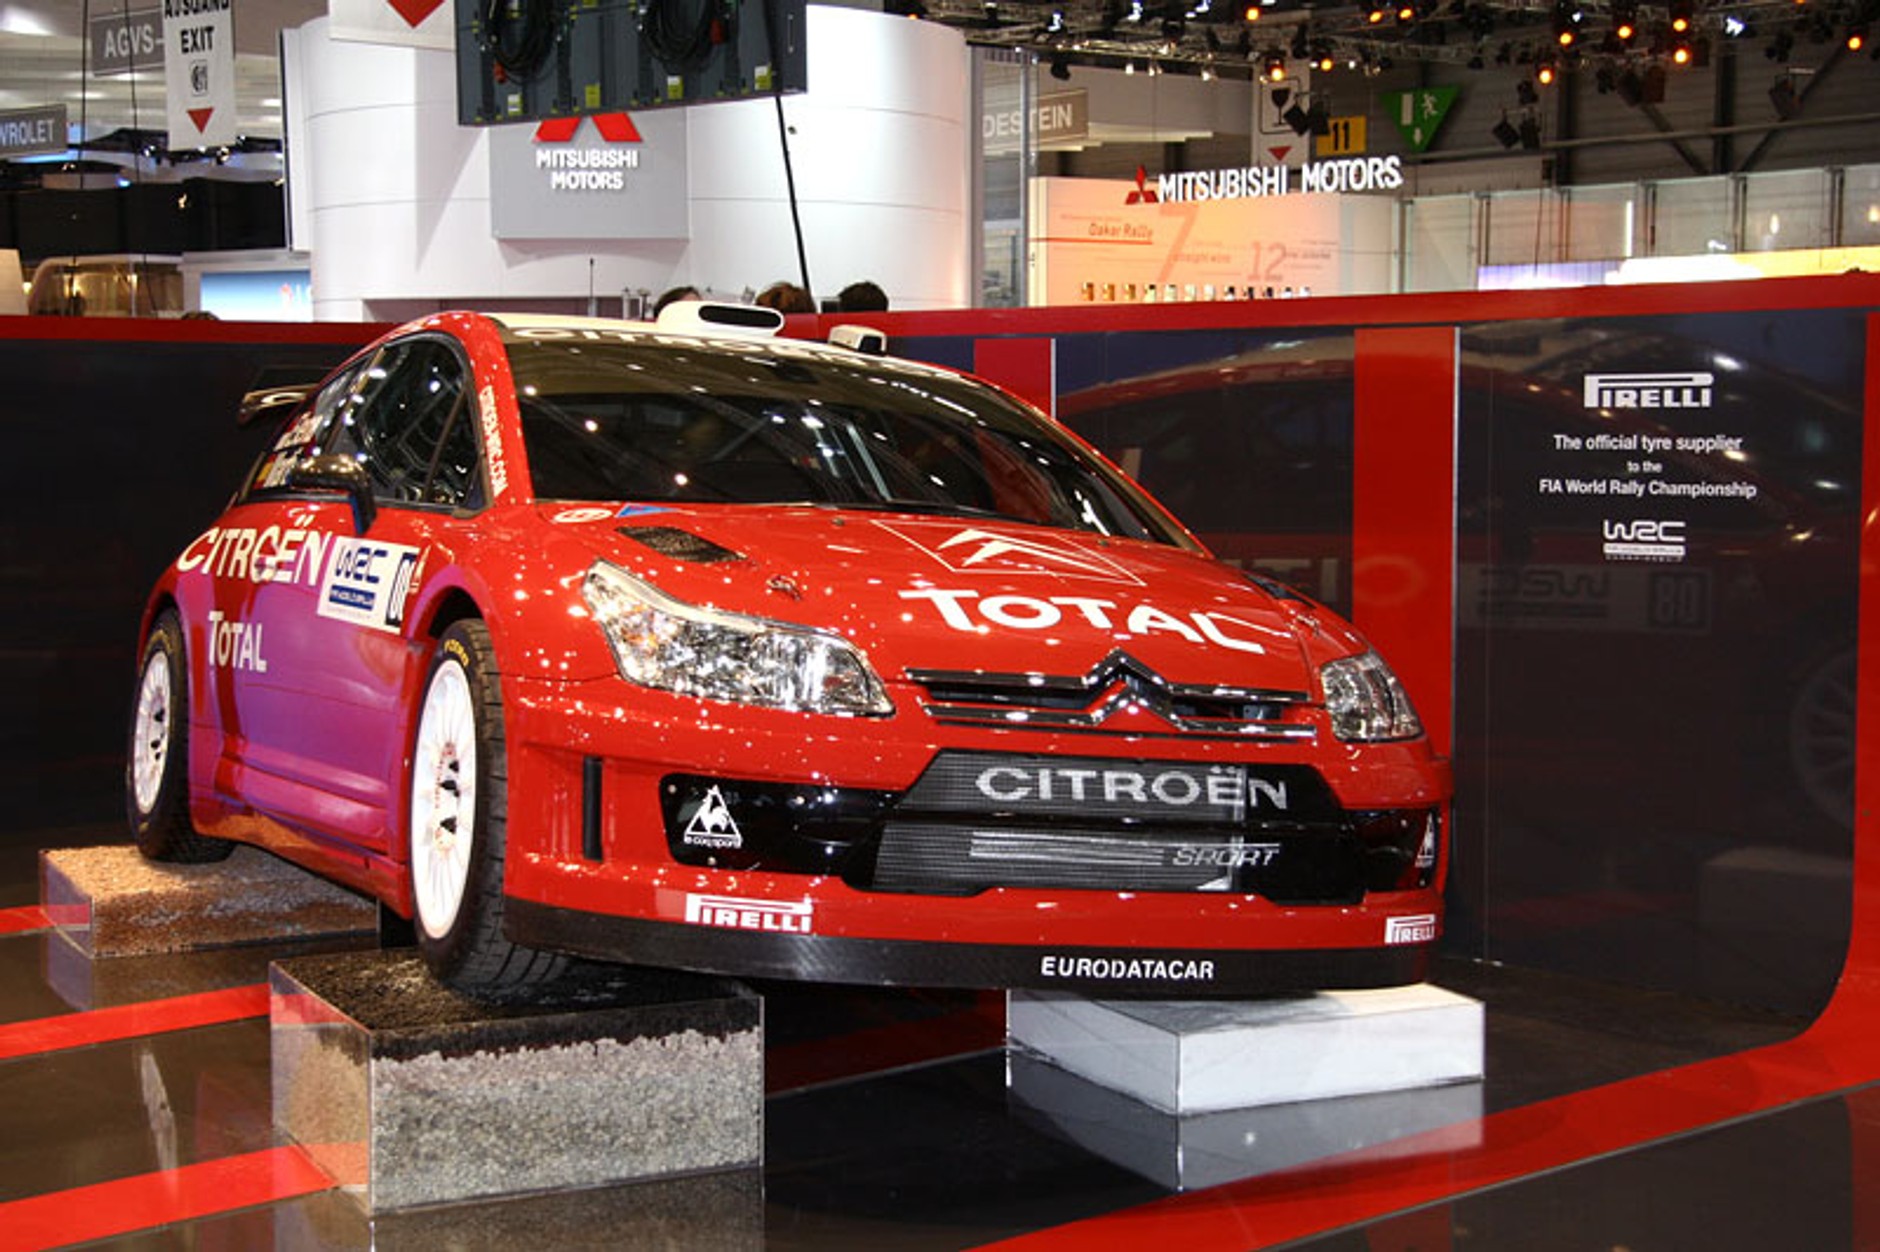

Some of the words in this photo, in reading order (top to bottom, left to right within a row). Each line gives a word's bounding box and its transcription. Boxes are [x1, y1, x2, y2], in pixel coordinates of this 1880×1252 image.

[180, 26, 215, 54] EXIT
[1332, 121, 1351, 151] 11
[535, 149, 638, 168] MITSUBISHI
[551, 171, 623, 190] MOTORS
[1158, 164, 1288, 203] MITSUBISHI
[1301, 155, 1402, 194] MOTORS
[1584, 373, 1714, 408] PIRELLI
[1553, 434, 1582, 450] The
[1585, 434, 1637, 450] official
[1641, 434, 1672, 454] tyre
[1675, 434, 1743, 454] supplier
[1626, 461, 1641, 473] to
[1642, 461, 1662, 472] the
[1539, 479, 1563, 493] FIA
[1565, 479, 1607, 494] World
[1609, 479, 1645, 497] Rally
[1648, 479, 1758, 499] Championship
[1604, 519, 1686, 542] WRC
[176, 513, 333, 587] CITROËN
[335, 544, 389, 584] WRC
[898, 589, 1266, 654] TOTAL
[208, 610, 267, 672] TOTAL
[975, 765, 1288, 810] CITROËN
[1173, 846, 1280, 867] SPORT
[685, 893, 813, 934] PIRELLI
[1384, 914, 1435, 944] PIRELLI
[1040, 956, 1215, 980] EURODATACAR
